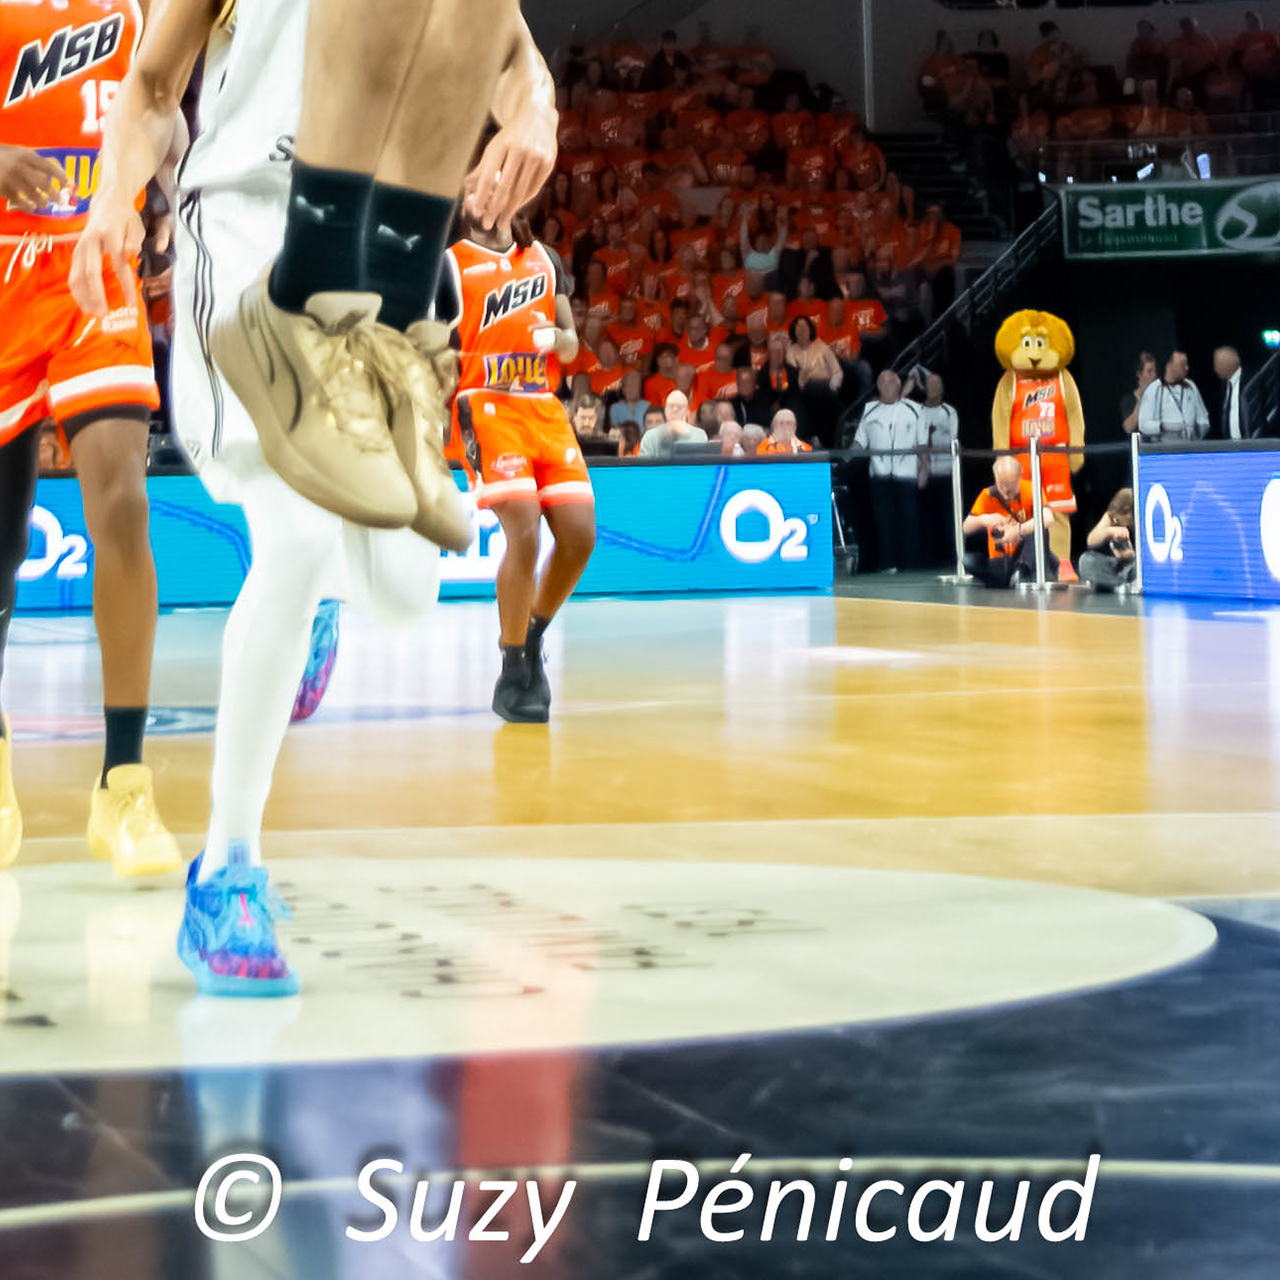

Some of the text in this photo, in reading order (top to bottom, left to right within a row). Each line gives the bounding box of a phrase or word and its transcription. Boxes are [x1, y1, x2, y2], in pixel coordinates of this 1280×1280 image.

[3, 11, 125, 109] MSB
[1077, 193, 1204, 228] Sarthe
[482, 272, 547, 329] MSB
